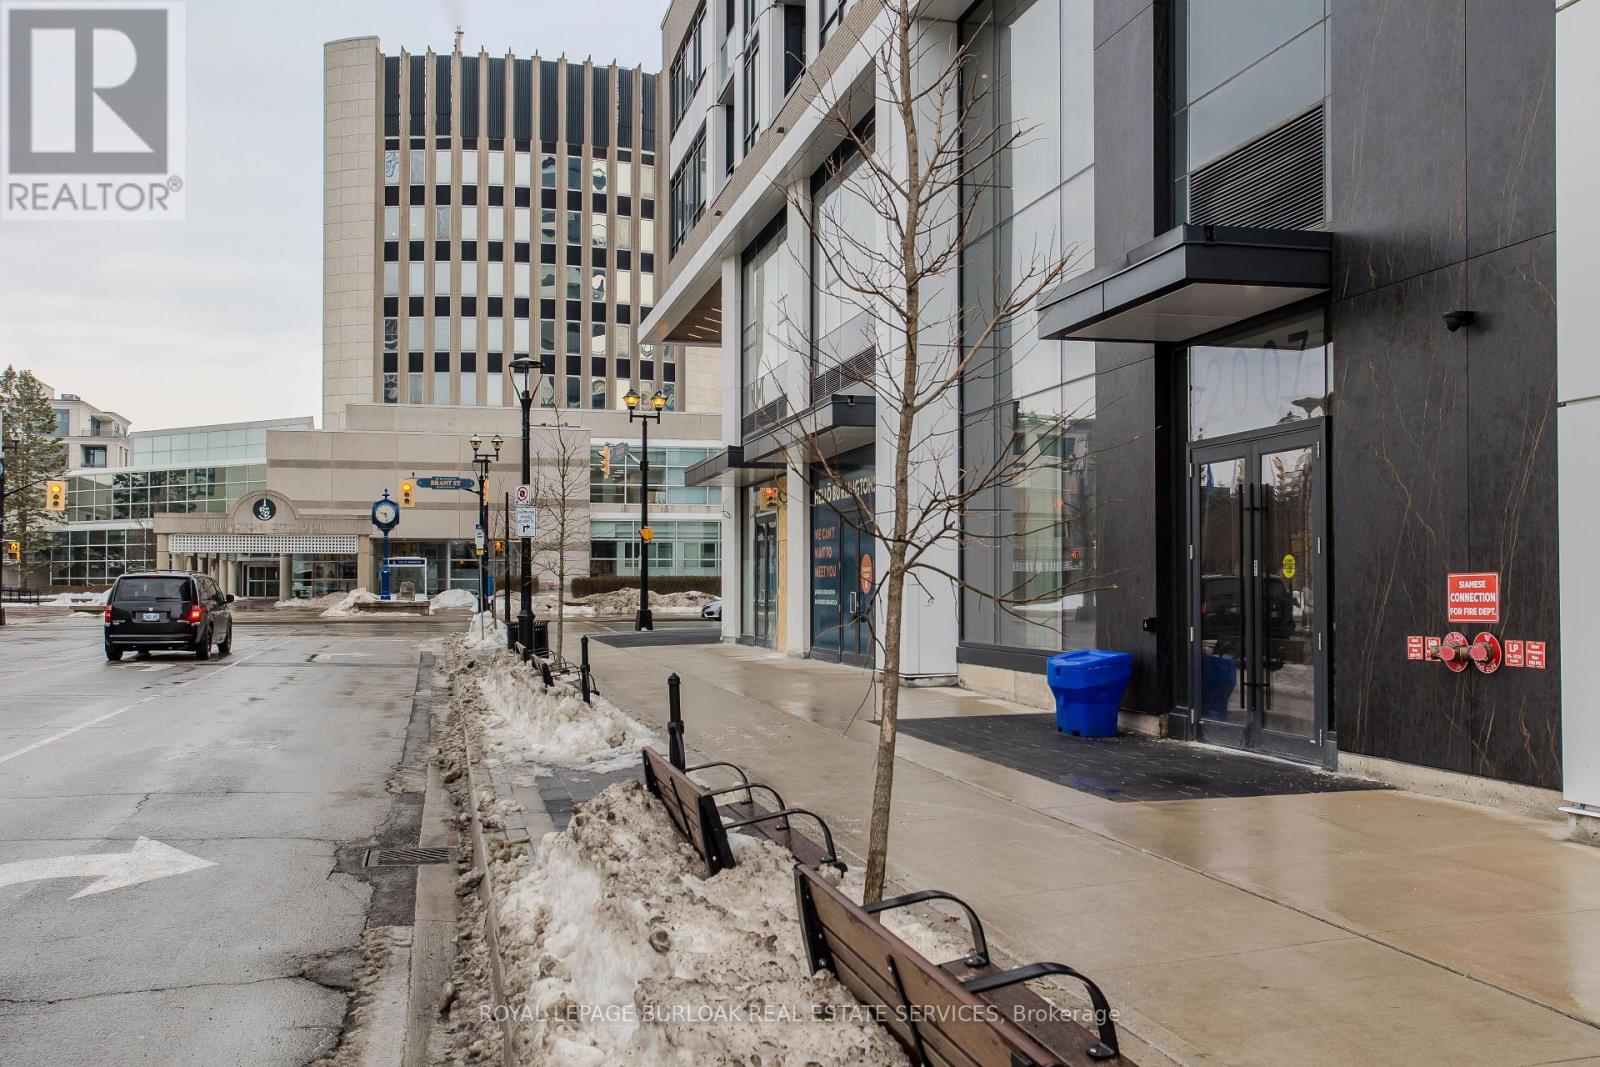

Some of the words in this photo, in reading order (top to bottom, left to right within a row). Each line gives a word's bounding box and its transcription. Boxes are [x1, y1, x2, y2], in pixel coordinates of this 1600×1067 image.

[1458, 580, 1486, 588] SIAMESE
[1450, 592, 1496, 602] CONNECTION
[1450, 607, 1463, 616] FOR
[1463, 607, 1478, 616] FIRE
[1478, 607, 1497, 616] DEPT.
[1509, 643, 1519, 653] LP
